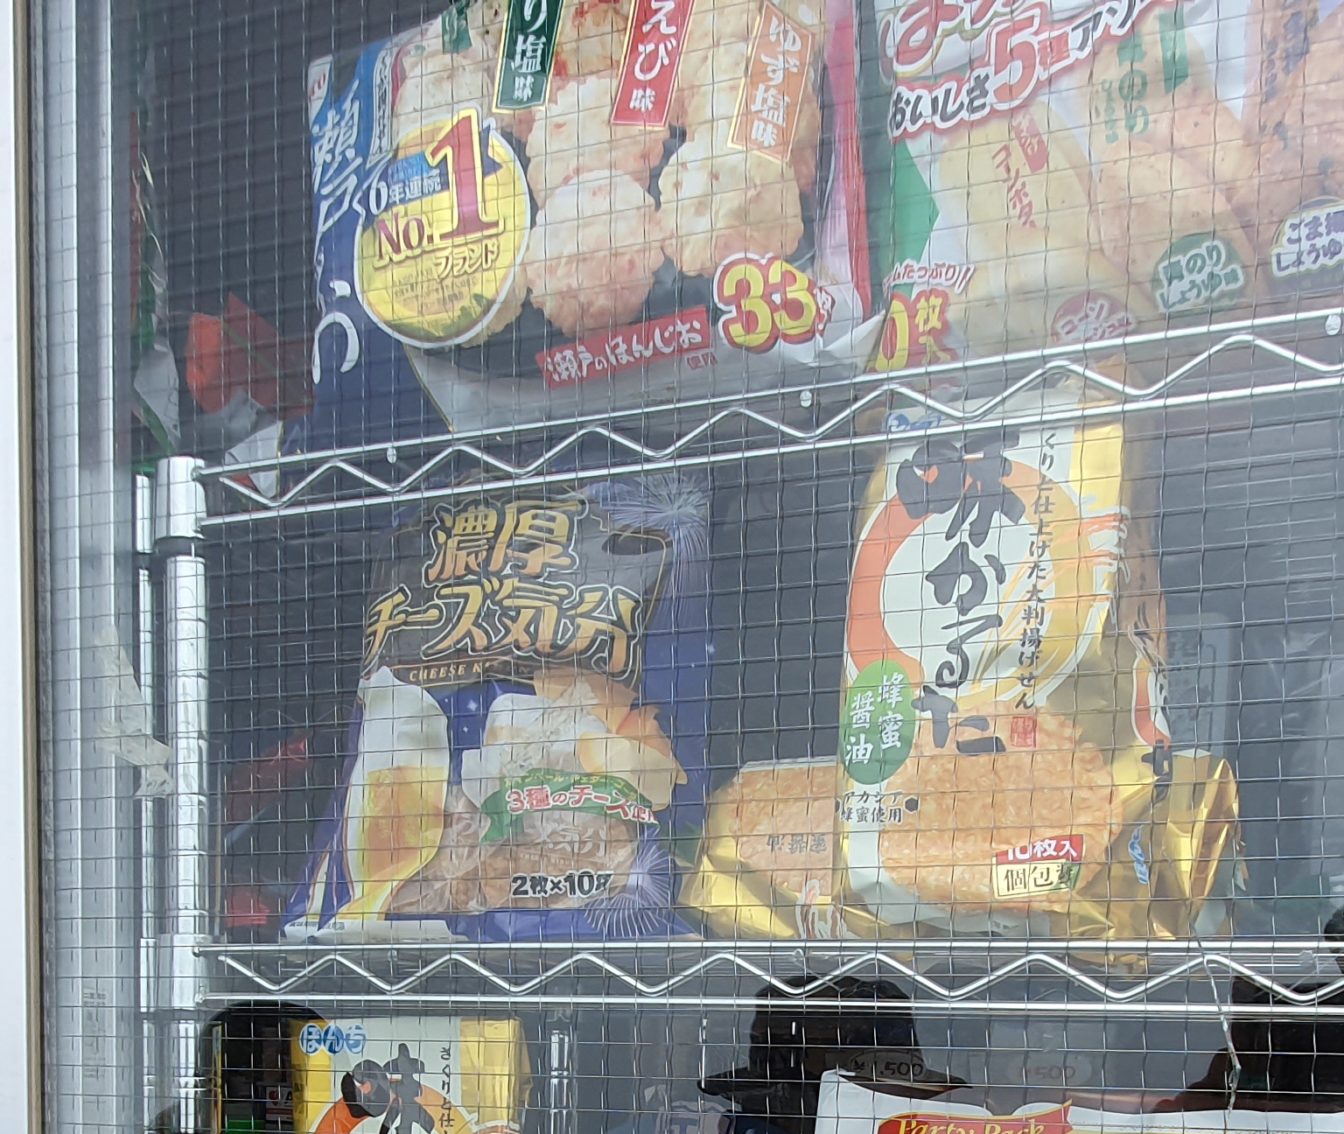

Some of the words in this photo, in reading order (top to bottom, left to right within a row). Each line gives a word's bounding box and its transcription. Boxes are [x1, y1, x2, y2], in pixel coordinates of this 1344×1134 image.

[749, 15, 803, 147] ゆず塩味
[544, 316, 704, 384] 瀬戸のほんじお
[425, 497, 588, 584] 濃厚
[363, 579, 643, 684] チーズ気分
[409, 662, 467, 682] CHEESE
[844, 692, 875, 767] 醤油
[876, 674, 906, 751] 蜂蜜
